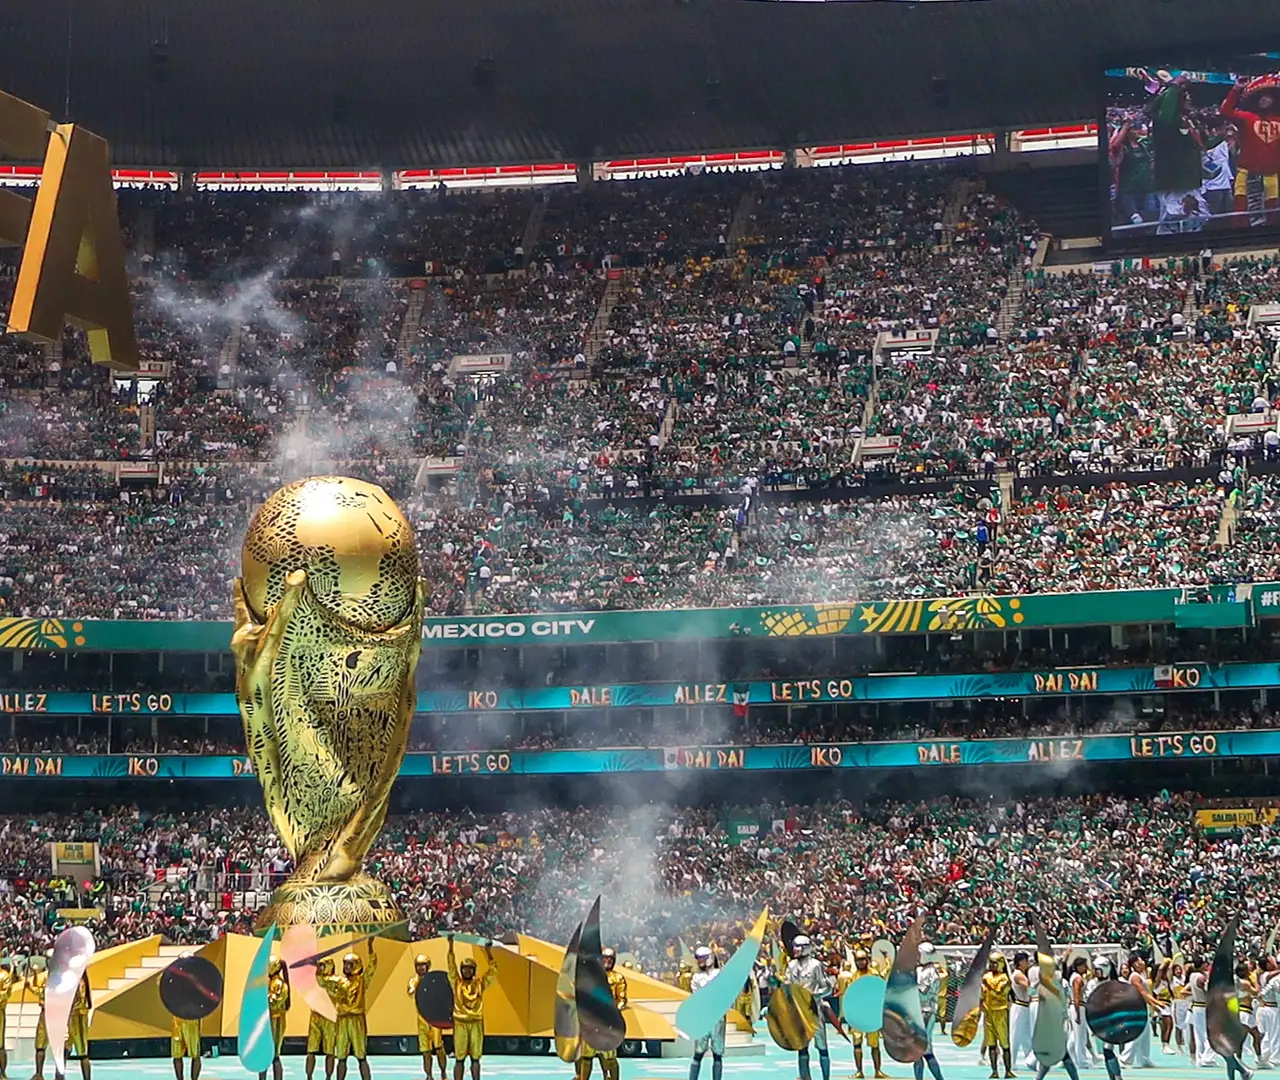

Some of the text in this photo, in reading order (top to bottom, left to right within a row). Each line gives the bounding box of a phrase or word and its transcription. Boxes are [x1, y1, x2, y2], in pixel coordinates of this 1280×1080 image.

[421, 619, 596, 638] MEXICO CITY
[771, 680, 853, 701] LET'S GO
[1034, 671, 1098, 692] DAI DAI
[92, 693, 172, 712] LET'S GO
[468, 690, 498, 708] IKO
[570, 687, 611, 706] DALE
[674, 684, 727, 704] ALLEZ
[918, 743, 961, 765] DALE
[1028, 740, 1084, 761] ALLEZ
[1130, 734, 1216, 757] LET'S GO
[2, 756, 62, 775] DAI DAI
[432, 753, 510, 773] LET'S GO
[684, 749, 744, 768] DAI DAI
[811, 746, 841, 766] IKO
[128, 757, 159, 776] IKO
[1212, 813, 1236, 822] SALIDA
[1238, 812, 1254, 820] EXIT
